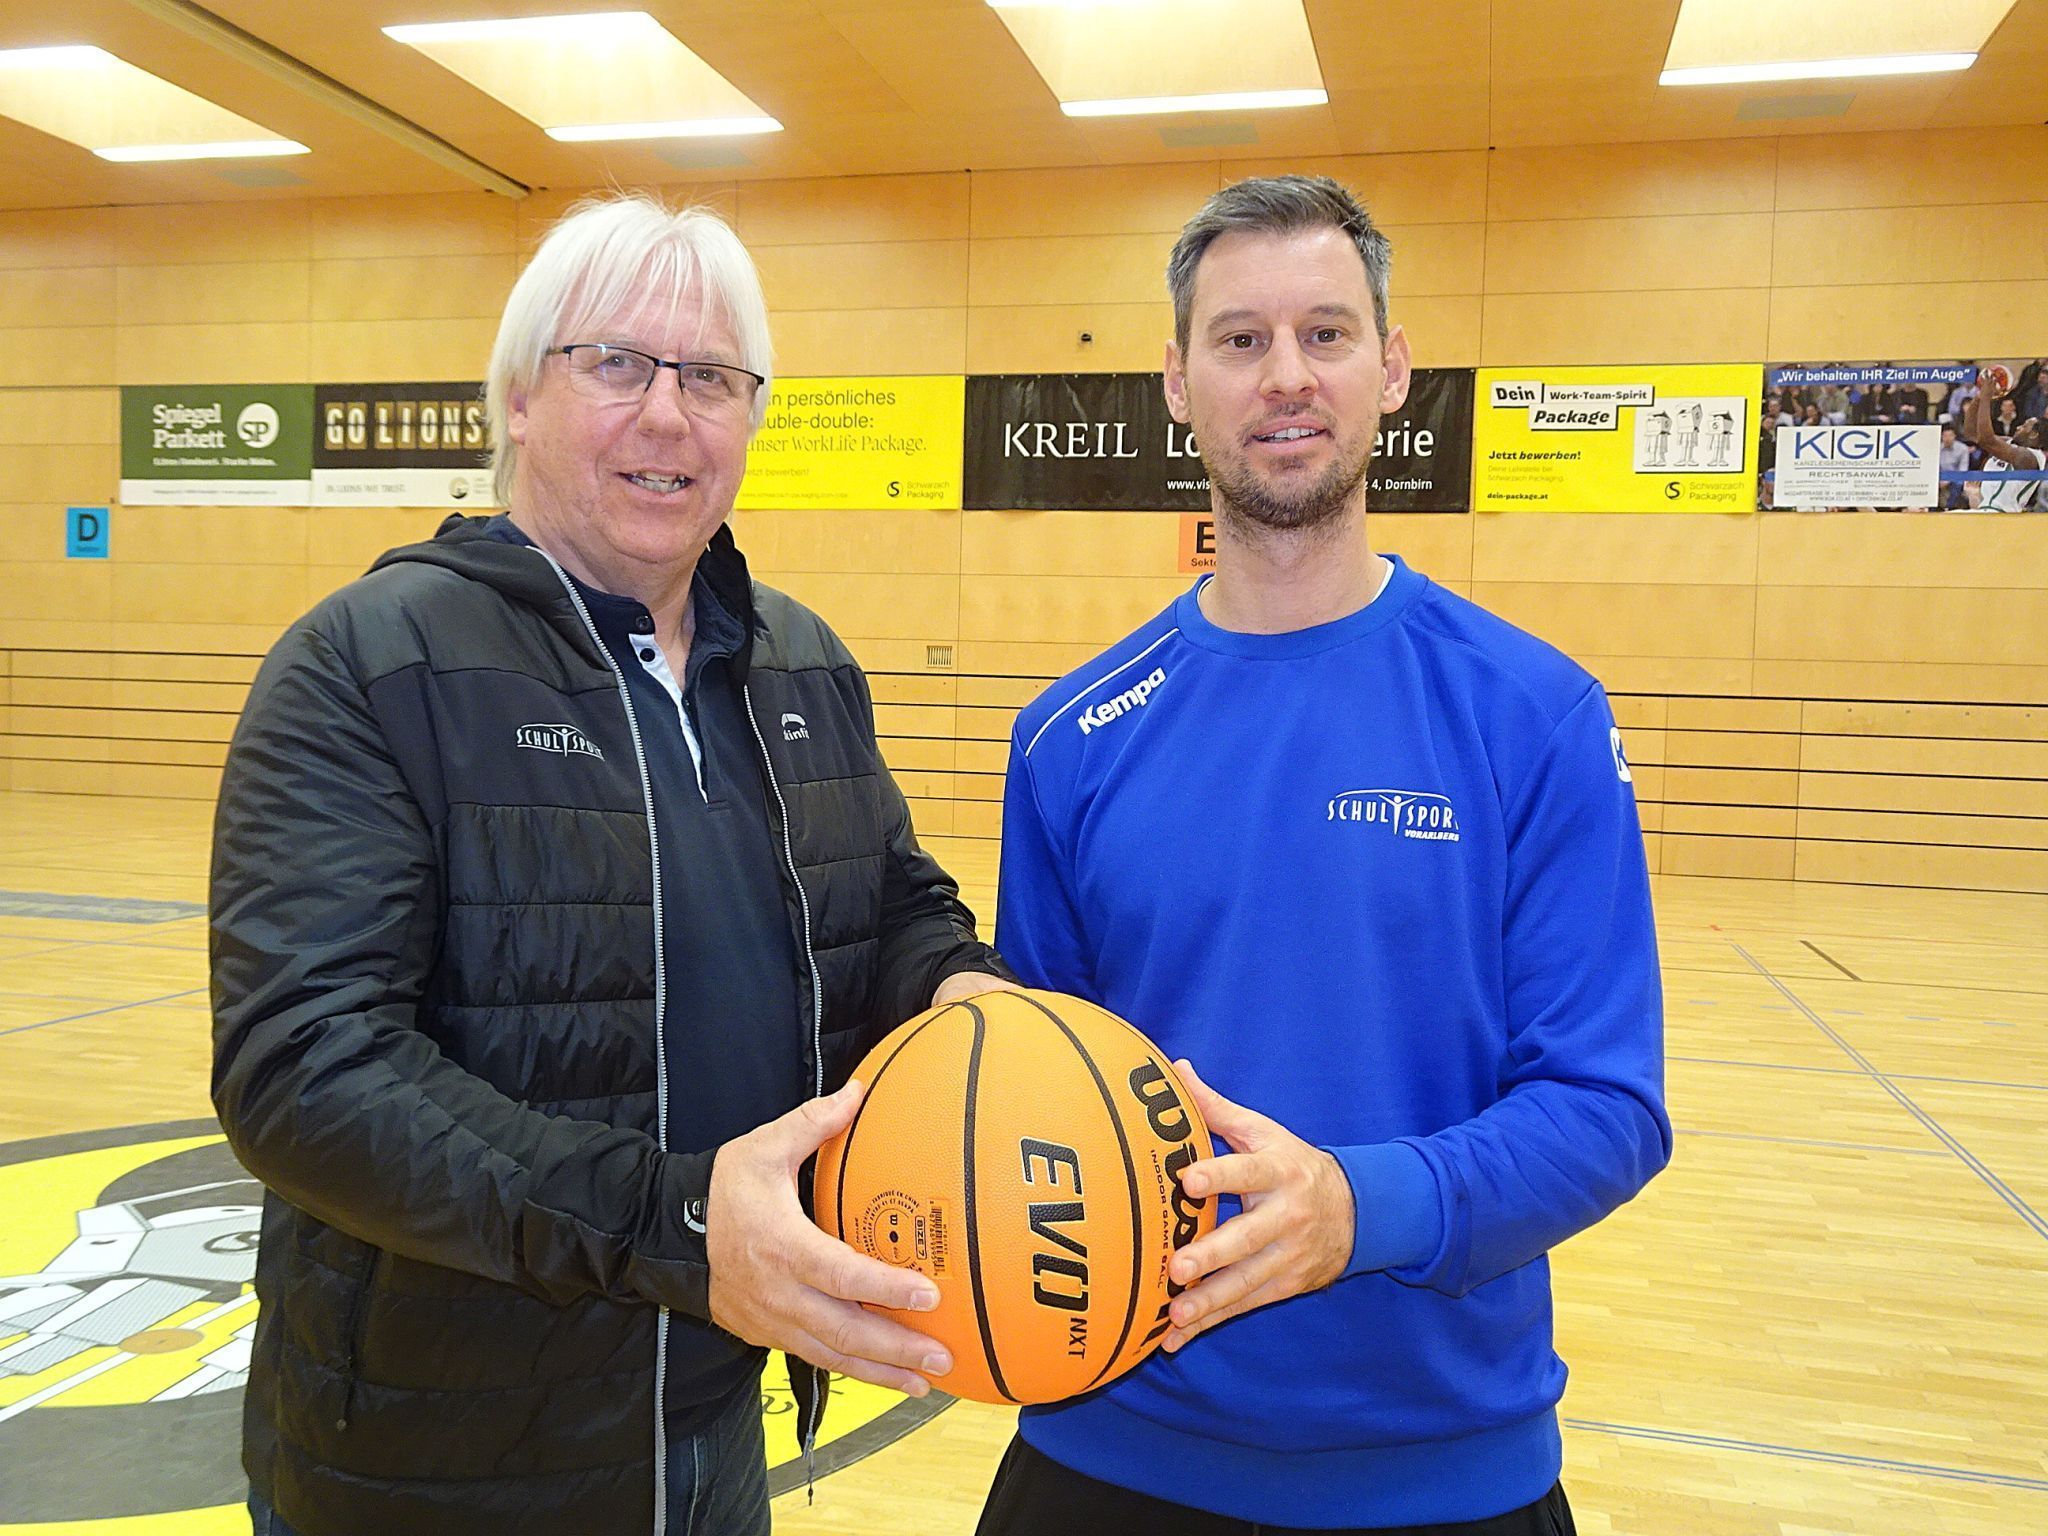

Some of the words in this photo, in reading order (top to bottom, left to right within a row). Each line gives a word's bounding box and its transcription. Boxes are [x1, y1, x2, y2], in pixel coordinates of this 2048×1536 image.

[1806, 371, 1858, 381] behalten
[1861, 370, 1883, 380] IHR
[1886, 370, 1909, 379] Ziel
[1912, 370, 1928, 379] im
[787, 389, 896, 410] persönliches
[1495, 387, 1536, 401] Dein
[1549, 390, 1647, 401] Work-Team-Spirit
[153, 402, 222, 429] Spiegel
[326, 407, 366, 444] GO
[378, 406, 482, 444] LIONS
[765, 412, 875, 429] uble-double:
[1534, 410, 1611, 425] Package
[152, 428, 227, 449] Parkett
[861, 433, 927, 456] Package.
[1004, 422, 1139, 458] KREIL
[1488, 451, 1517, 460] Jetzt
[1519, 451, 1581, 460] bewerben!
[906, 490, 944, 500] Packaging
[1385, 478, 1432, 490] Dornbirn
[1689, 481, 1744, 490] Schwarzach
[1689, 491, 1737, 502] Packaging
[78, 513, 98, 541] D
[1077, 666, 1167, 736] Kempa
[516, 728, 560, 750] SCHUL
[1327, 799, 1389, 823] SCHUL
[1406, 804, 1459, 831] SPOR
[1150, 1149, 1168, 1205] INDOOR
[916, 1219, 925, 1245] SIZE
[1019, 1136, 1090, 1312] EVO
[1162, 1208, 1170, 1250] GAME
[1157, 1254, 1169, 1289] BALL
[1067, 1317, 1089, 1360] NXT
